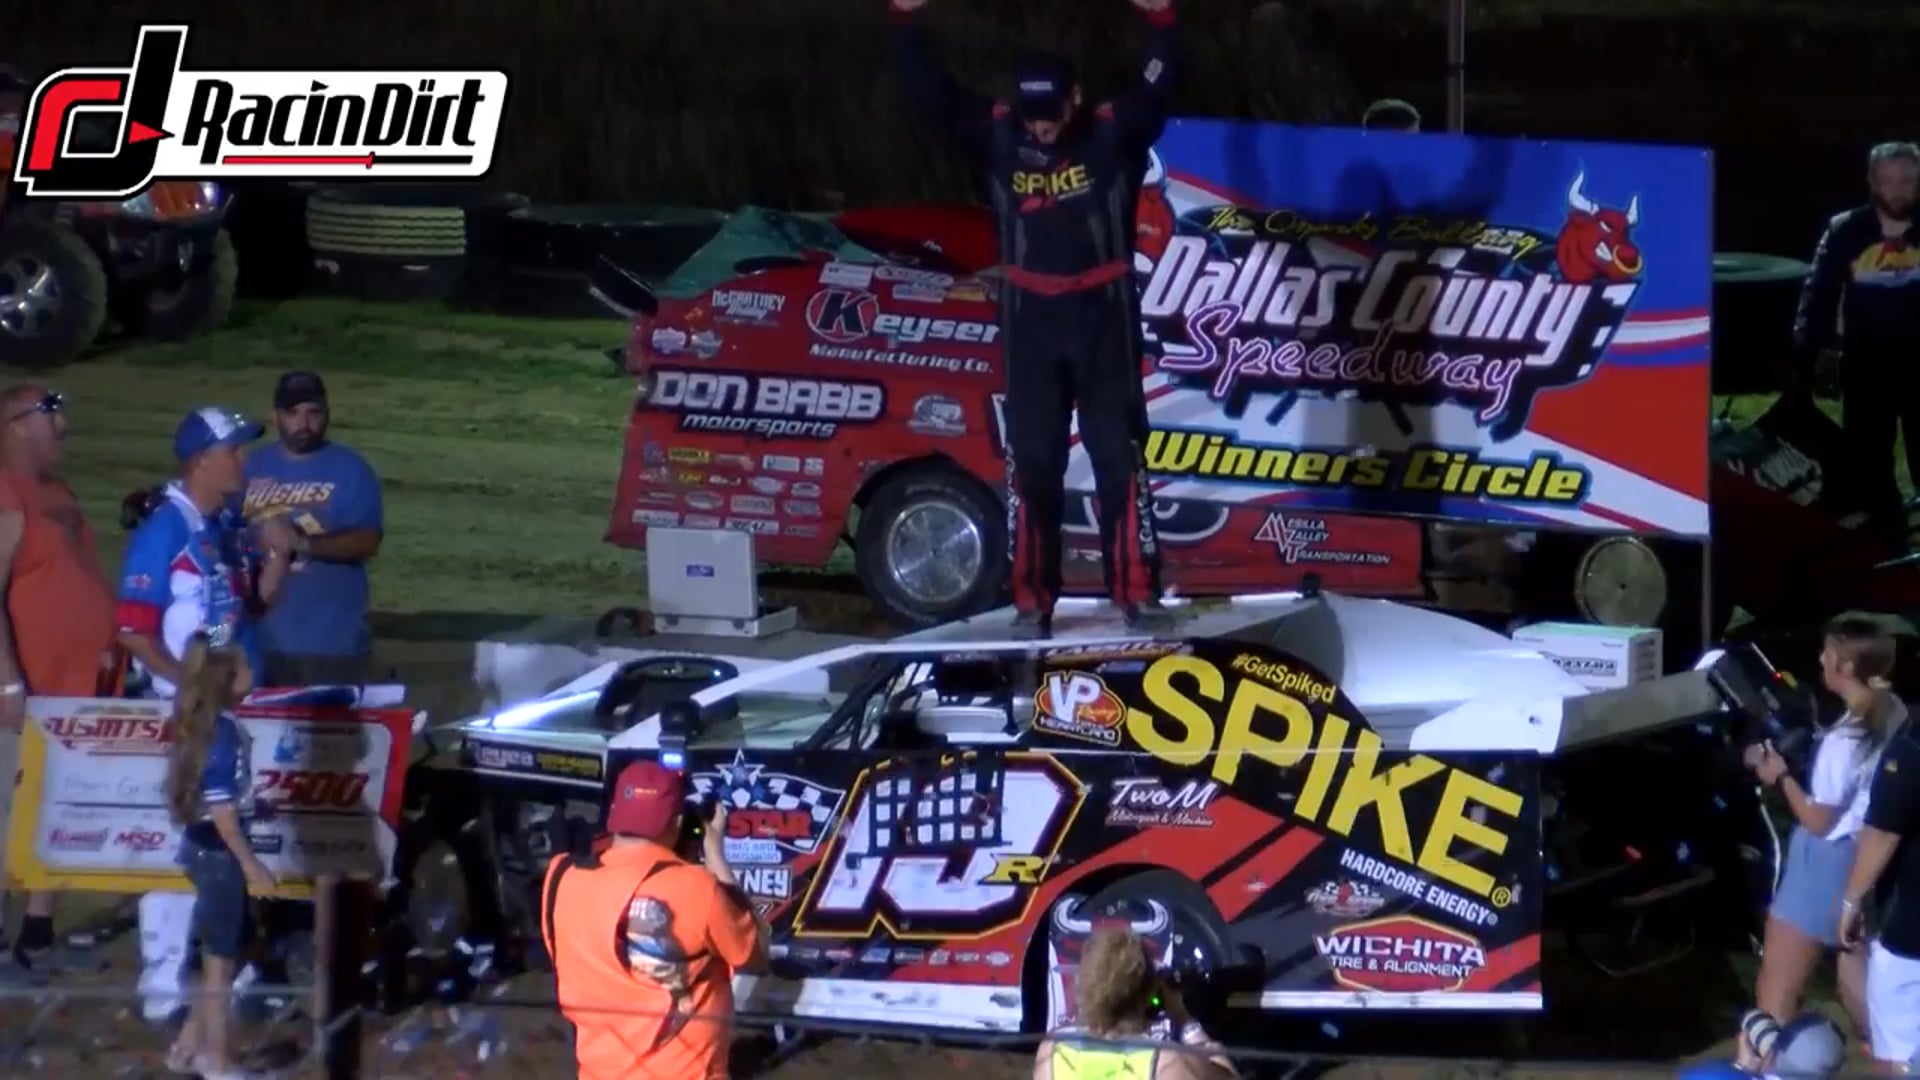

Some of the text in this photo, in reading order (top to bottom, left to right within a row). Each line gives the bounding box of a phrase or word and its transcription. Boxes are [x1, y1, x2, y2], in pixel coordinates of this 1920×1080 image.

[1012, 163, 1090, 195] SPIKE
[1141, 235, 1591, 366] Dallas County
[810, 343, 961, 372] Manufacturing
[1159, 301, 1522, 420] Speedway
[652, 370, 750, 414] DON
[754, 377, 883, 419] BABB
[682, 413, 838, 438] motorsports
[1143, 430, 1584, 500] Winners Circle
[1049, 674, 1102, 725] VP
[1231, 653, 1337, 703] #GetSpiked
[1127, 655, 1524, 897] SPIKE
[113, 830, 166, 847] MSD
[1340, 847, 1424, 898] HARDCORE
[1425, 888, 1490, 925] ENERGY
[1316, 935, 1486, 967] WICHITA
[1330, 955, 1472, 978] TIRE & ALIGNMENT
